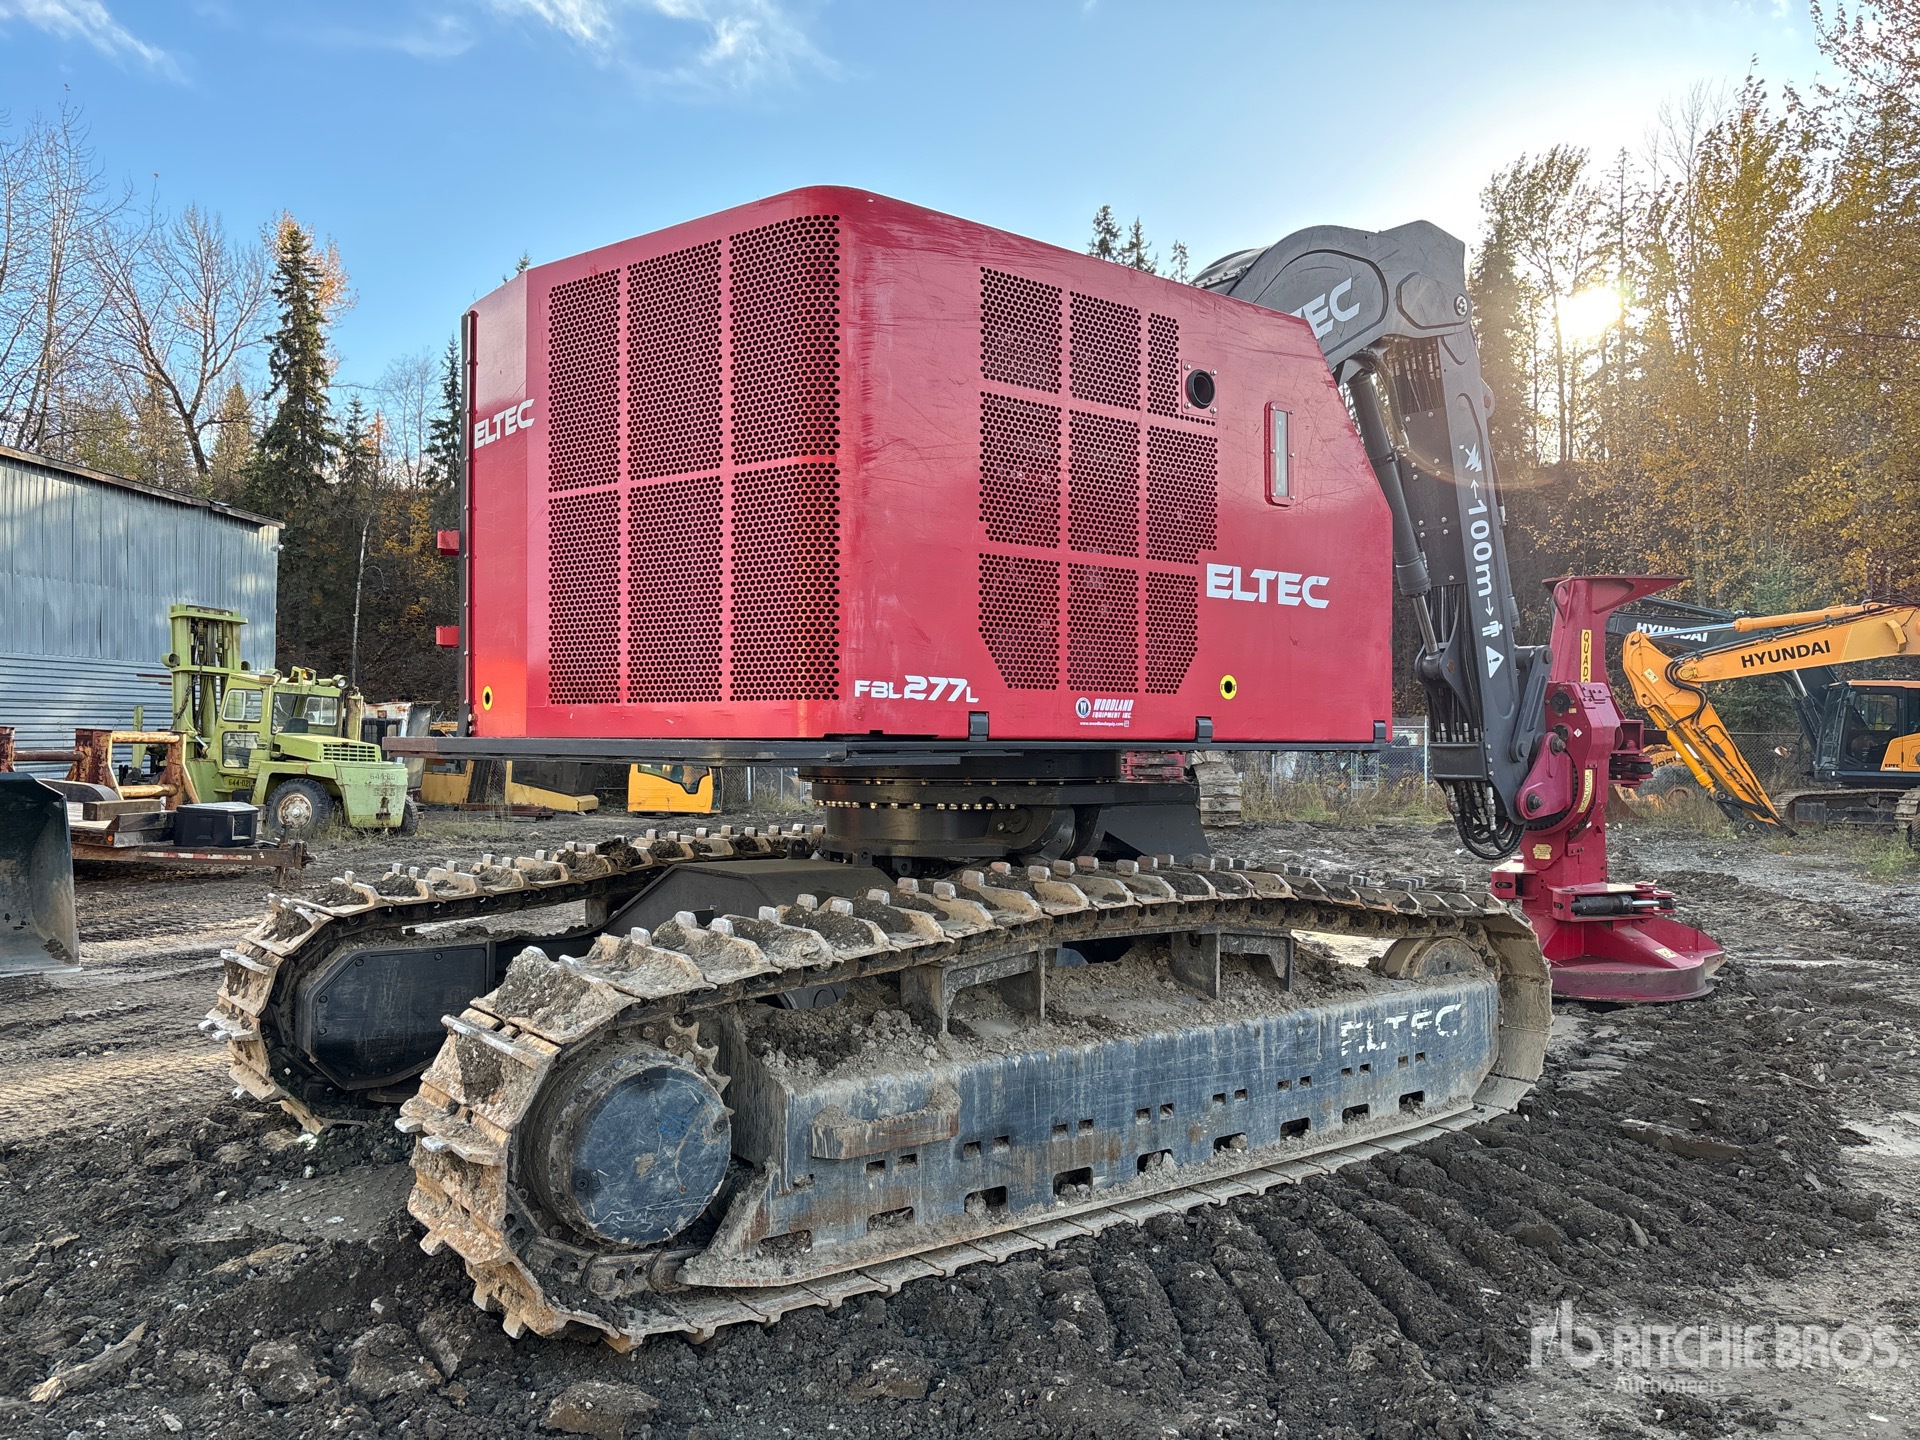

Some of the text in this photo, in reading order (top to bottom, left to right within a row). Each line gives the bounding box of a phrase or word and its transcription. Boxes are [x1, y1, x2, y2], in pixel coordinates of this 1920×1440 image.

[1290, 277, 1361, 340] EC
[474, 398, 536, 449] ELTEC
[1468, 499, 1493, 597] 100m
[1206, 563, 1330, 609] ELTEC
[1740, 640, 1832, 669] HYUNDAI
[1092, 711, 1121, 719] EQUIPMENT
[1093, 698, 1134, 712] WOODLAND
